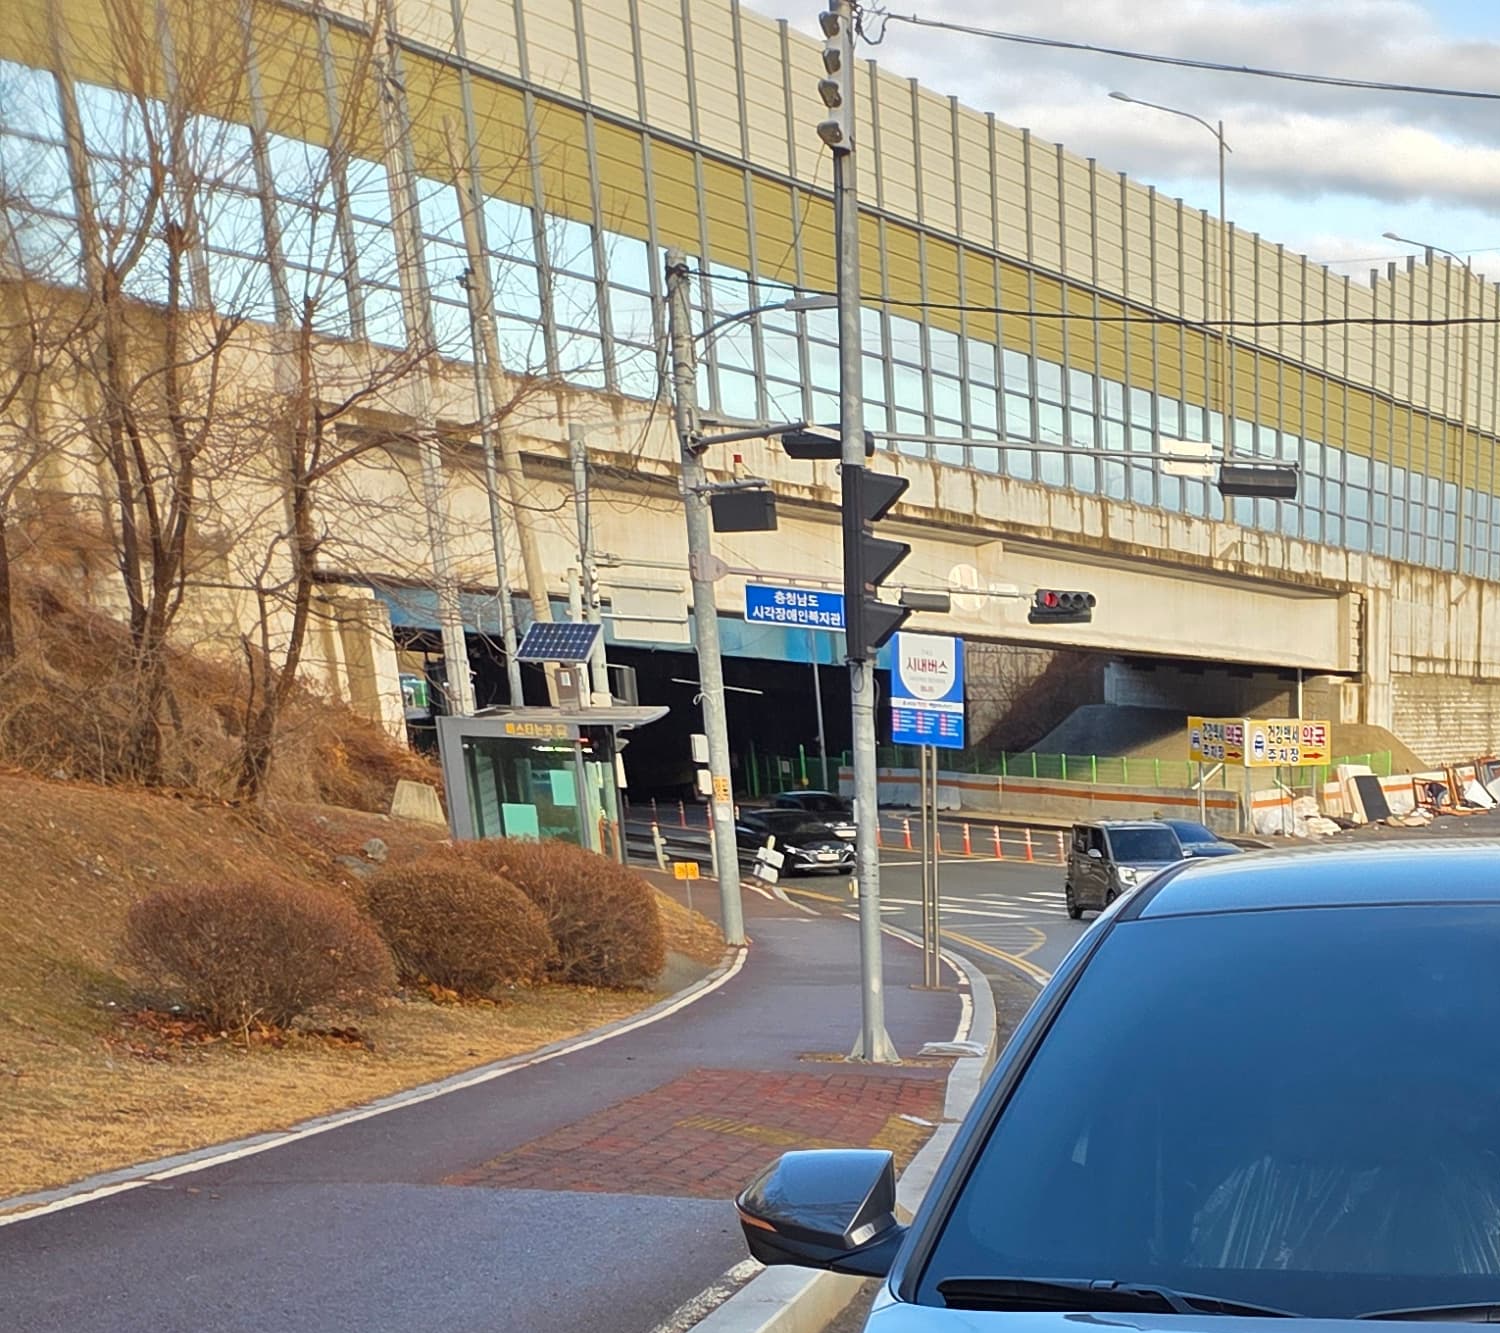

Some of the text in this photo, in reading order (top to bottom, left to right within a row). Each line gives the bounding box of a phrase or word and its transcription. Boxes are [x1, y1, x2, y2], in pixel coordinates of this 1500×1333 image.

[774, 591, 819, 607] 충청남도
[752, 605, 841, 626] 시각장애인복지관
[906, 657, 949, 674] 시내버스
[1267, 748, 1299, 762] 주차장
